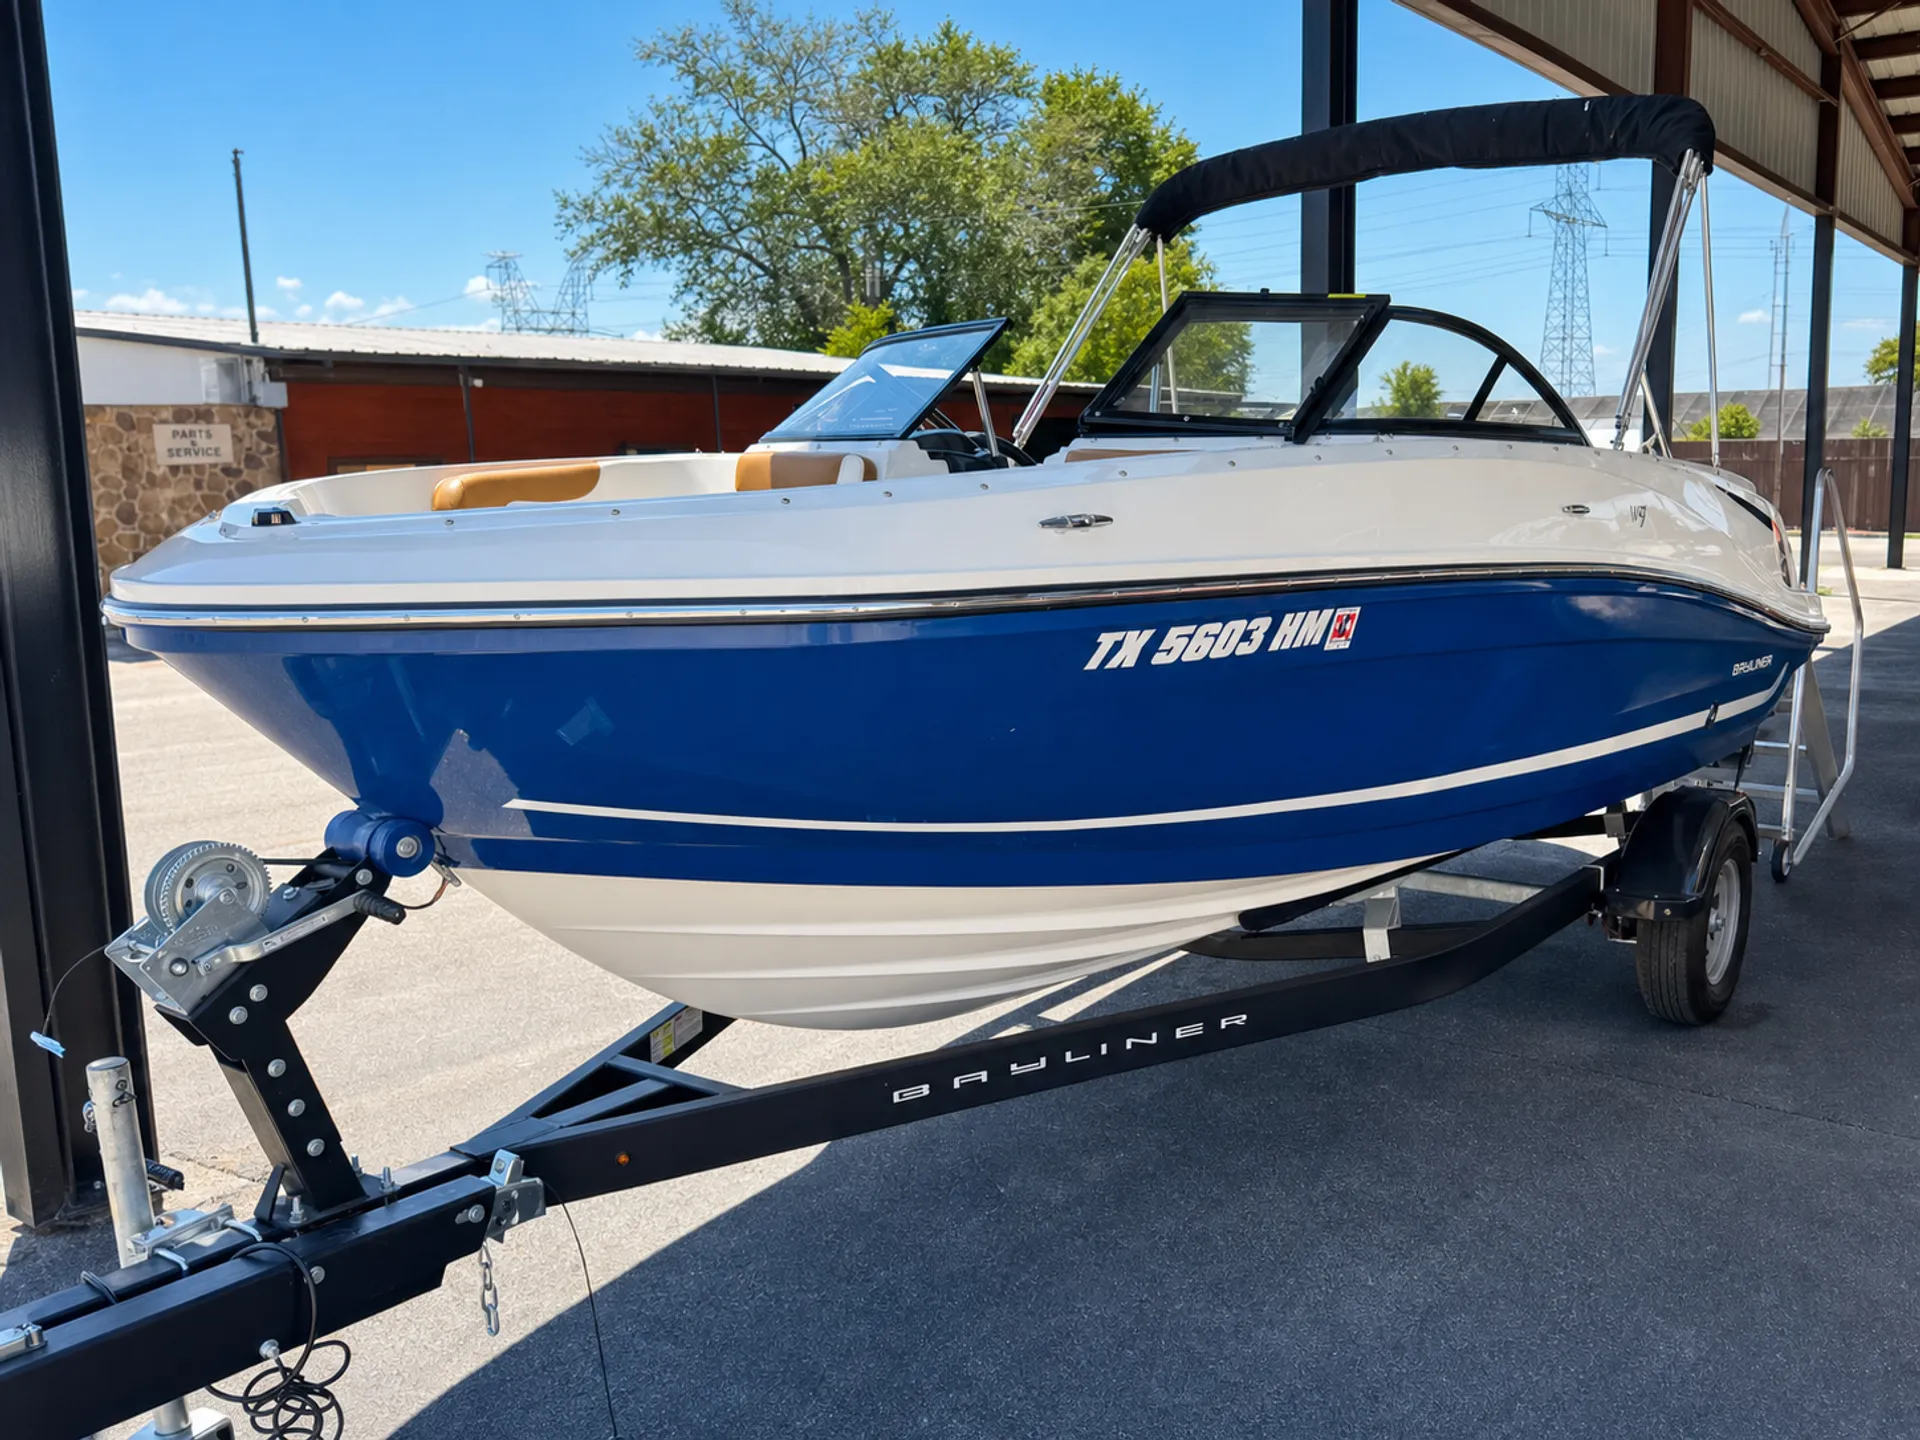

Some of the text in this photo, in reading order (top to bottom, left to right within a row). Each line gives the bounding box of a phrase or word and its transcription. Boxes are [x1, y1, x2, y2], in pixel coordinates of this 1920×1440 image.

[171, 429, 213, 440] PARTS
[167, 447, 222, 458] SERVICE
[1083, 629, 1157, 671] TX
[1150, 616, 1273, 666] 5603
[1268, 608, 1335, 652] HM
[1731, 654, 1774, 677] BAYLINER
[893, 1013, 1248, 1104] BAYLINER
